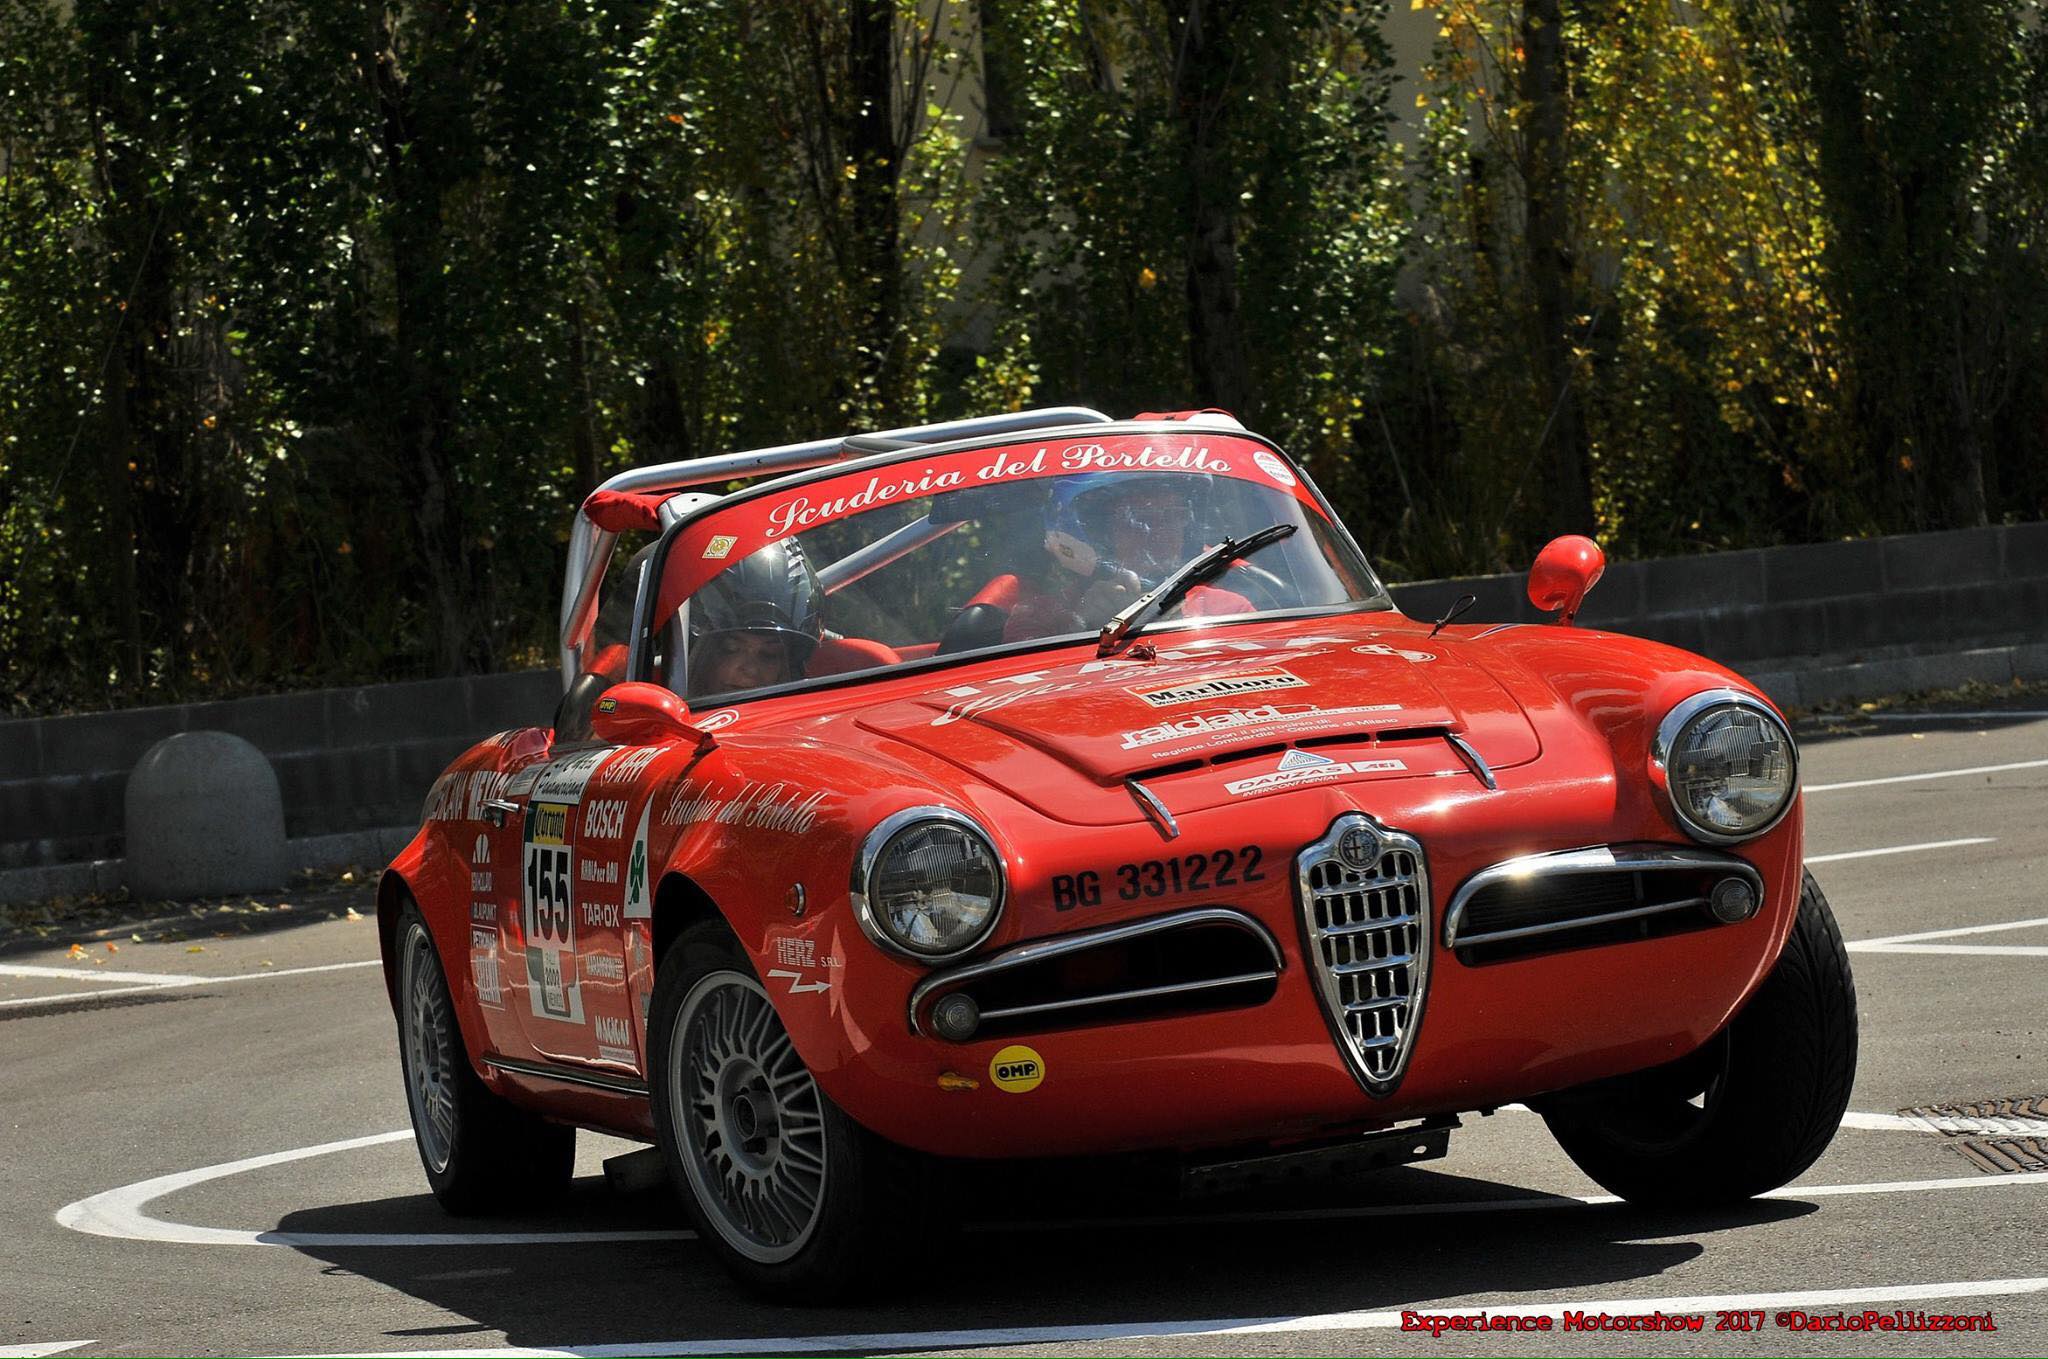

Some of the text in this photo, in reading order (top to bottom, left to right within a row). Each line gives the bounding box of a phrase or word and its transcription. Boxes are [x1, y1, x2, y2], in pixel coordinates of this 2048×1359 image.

[765, 468, 966, 538] Scuderia
[977, 447, 1048, 481] del
[1061, 443, 1233, 473] Portello
[1146, 677, 1297, 702] Marlboro
[1121, 705, 1281, 749] raidaid
[1151, 744, 1205, 759] Regione
[1206, 731, 1276, 748] Lombardia
[1286, 723, 1341, 733] Comune
[1356, 717, 1399, 726] Milano
[1210, 732, 1238, 740] Con
[1250, 721, 1315, 735] patrocinio
[1237, 766, 1343, 790] DANZAS
[583, 800, 629, 839] BOSCH
[715, 781, 766, 826] del
[745, 782, 830, 834] Portello
[527, 847, 571, 945] 155
[1052, 845, 1266, 912] BG 331222
[776, 936, 816, 968] HERZ
[997, 1062, 1037, 1079] OMP
